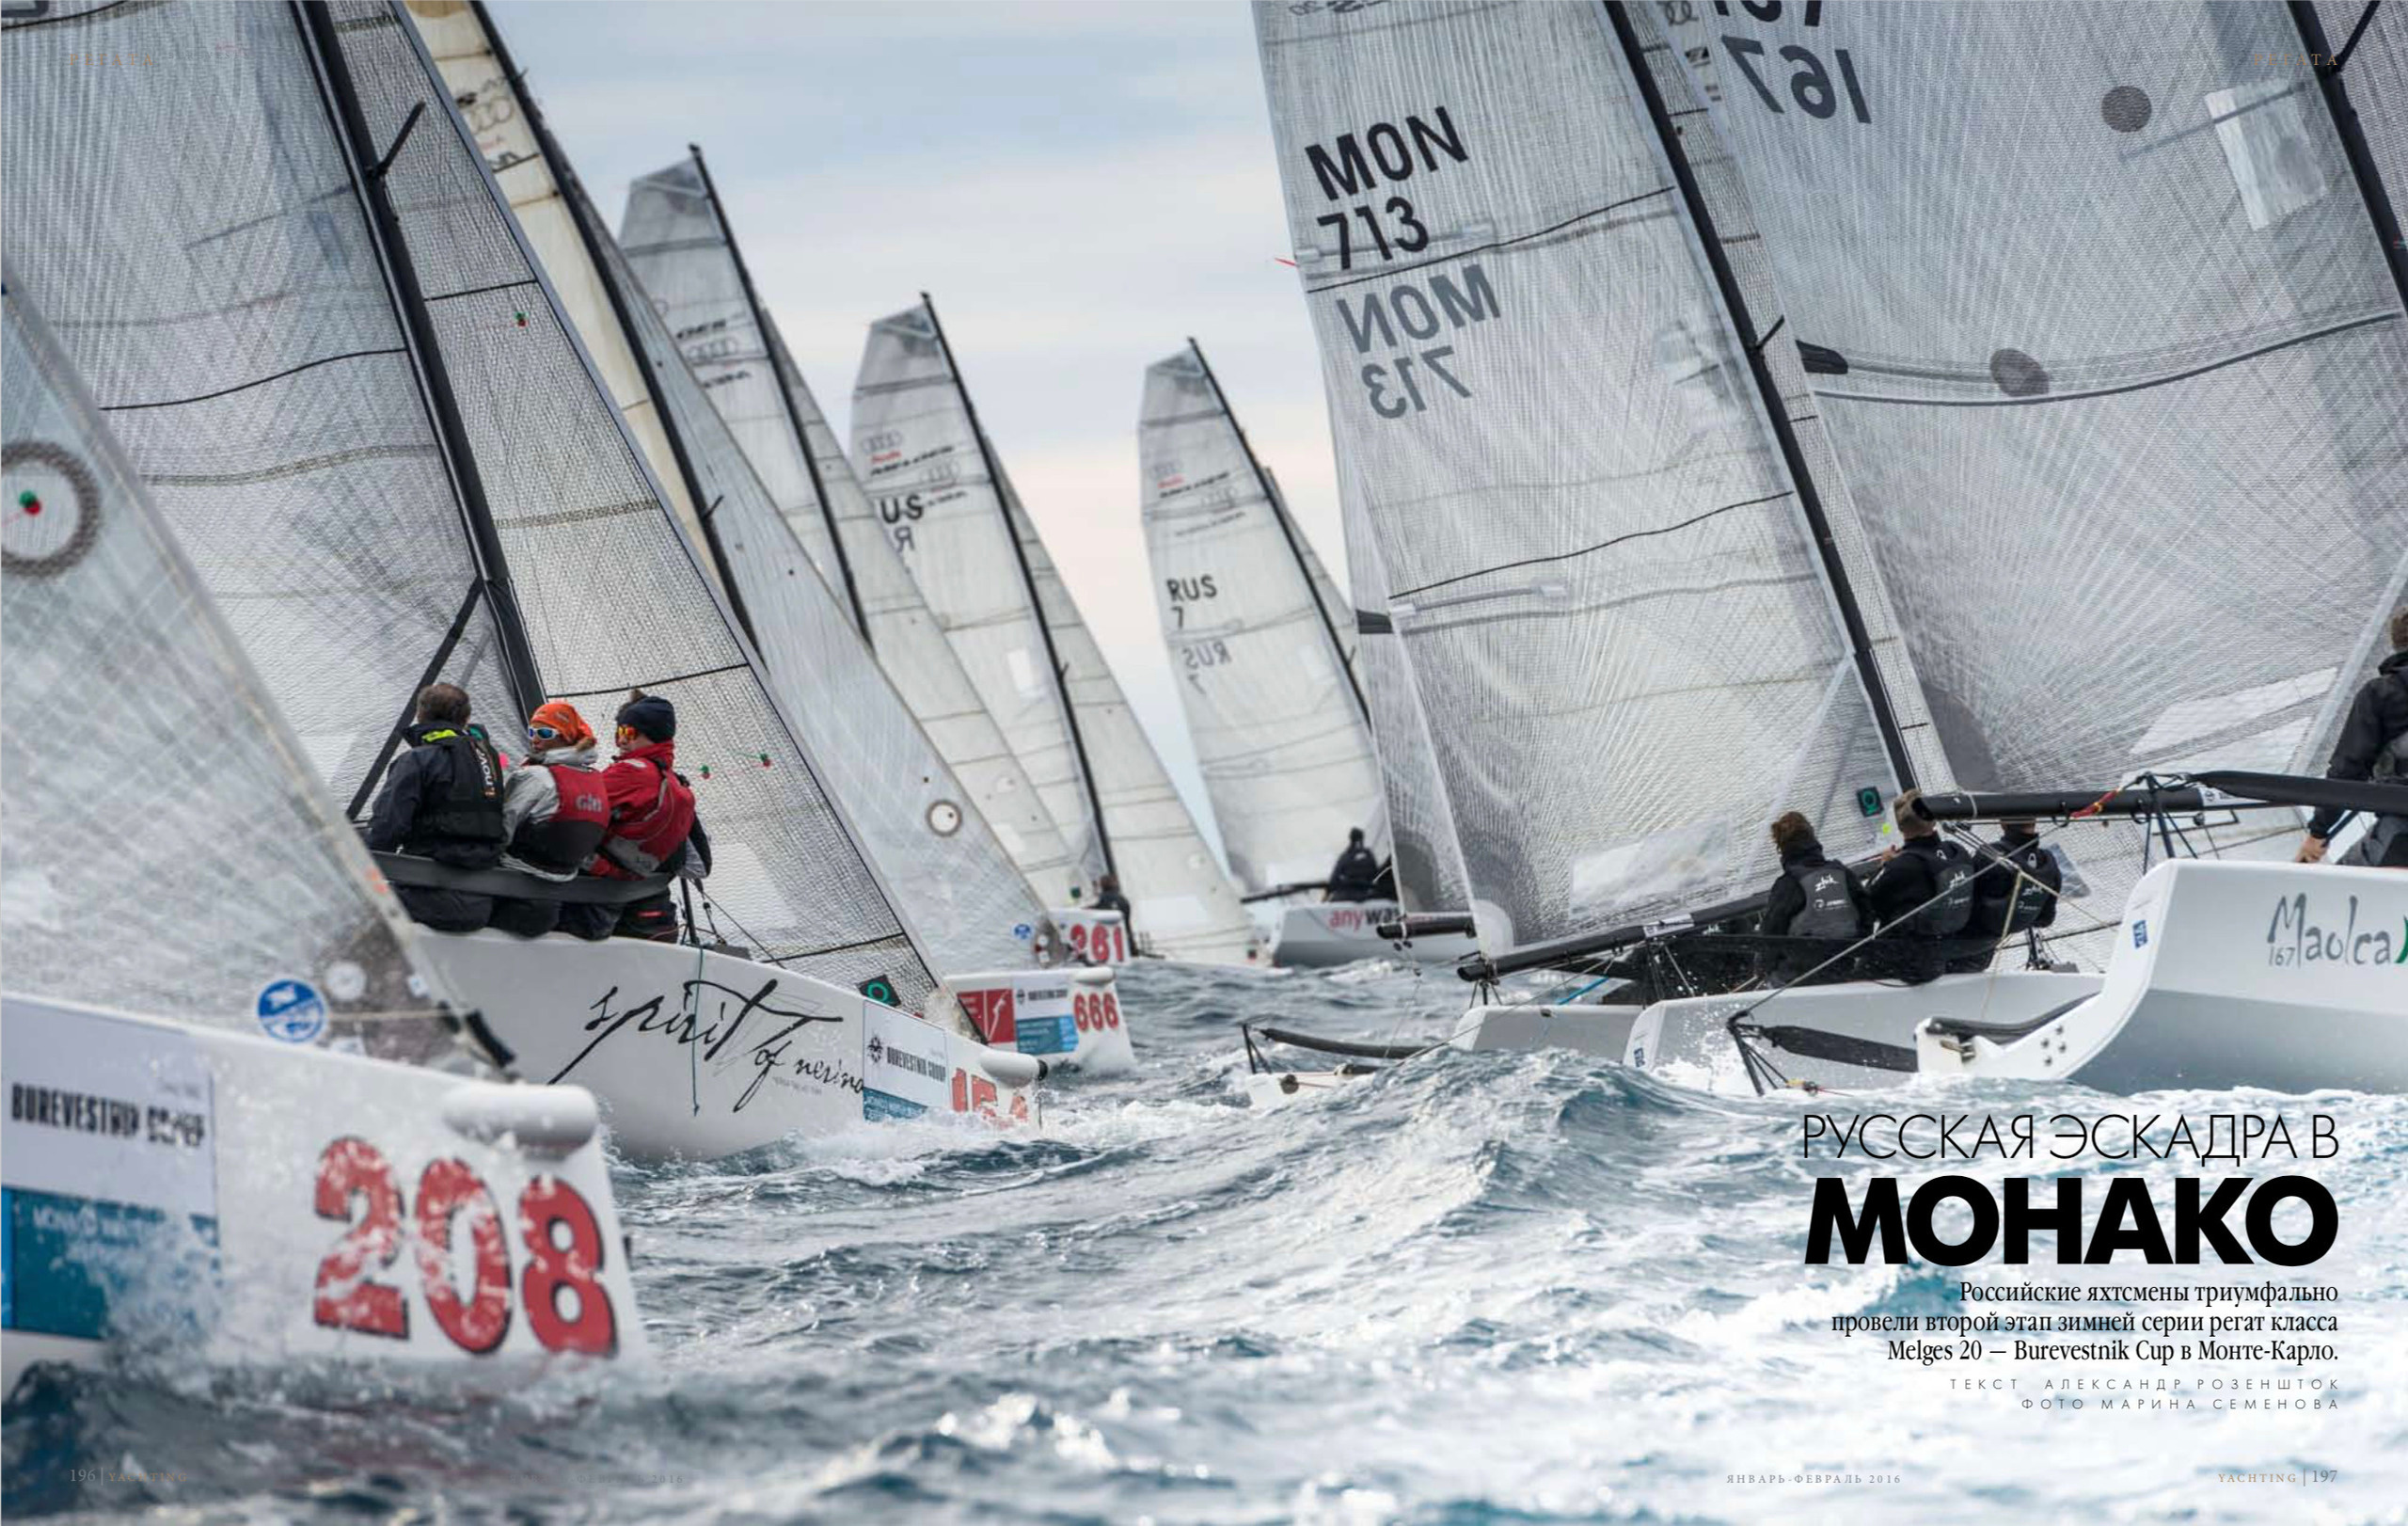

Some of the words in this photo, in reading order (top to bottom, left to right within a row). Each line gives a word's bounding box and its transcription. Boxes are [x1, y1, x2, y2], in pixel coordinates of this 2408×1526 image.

[1305, 105, 1470, 201] MON
[1318, 196, 1430, 271] 713
[879, 494, 925, 524] US
[1165, 573, 1217, 602] RUS
[1171, 606, 1184, 629] 7
[1329, 907, 1402, 931] anywa
[2269, 946, 2296, 967] 167
[1073, 992, 1119, 1032] 666
[313, 1135, 618, 1359] 208
